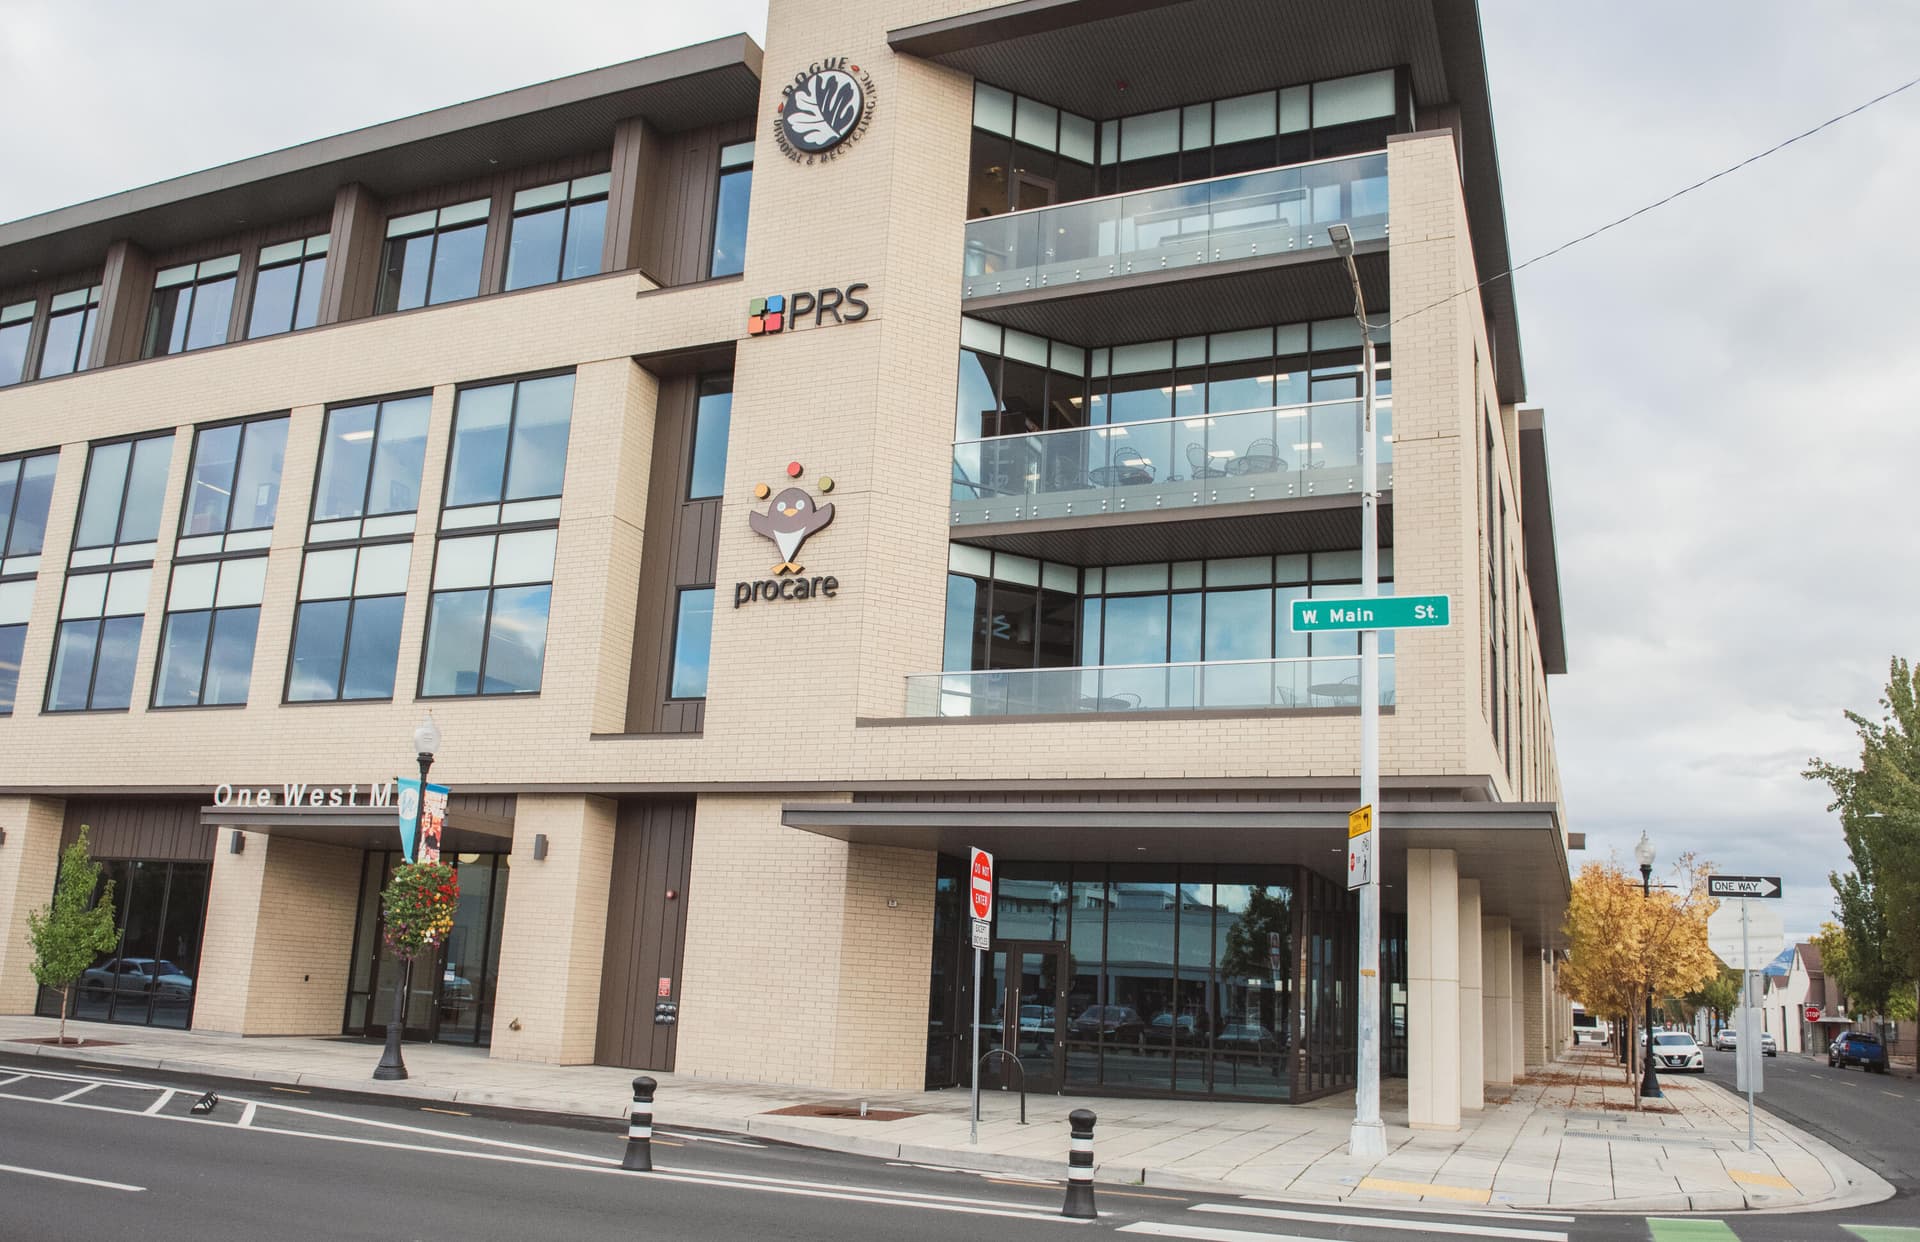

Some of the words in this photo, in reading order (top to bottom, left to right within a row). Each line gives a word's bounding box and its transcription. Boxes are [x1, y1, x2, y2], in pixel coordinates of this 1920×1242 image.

[782, 56, 849, 97] ROGUE
[789, 283, 869, 330] PRS
[734, 575, 839, 609] procare
[1302, 609, 1319, 624] W.
[1330, 608, 1374, 623] Main
[1414, 605, 1439, 619] St.
[214, 783, 271, 807] One
[283, 783, 358, 807] West
[1714, 881, 1735, 891] ONE
[1738, 882, 1758, 892] WAY
